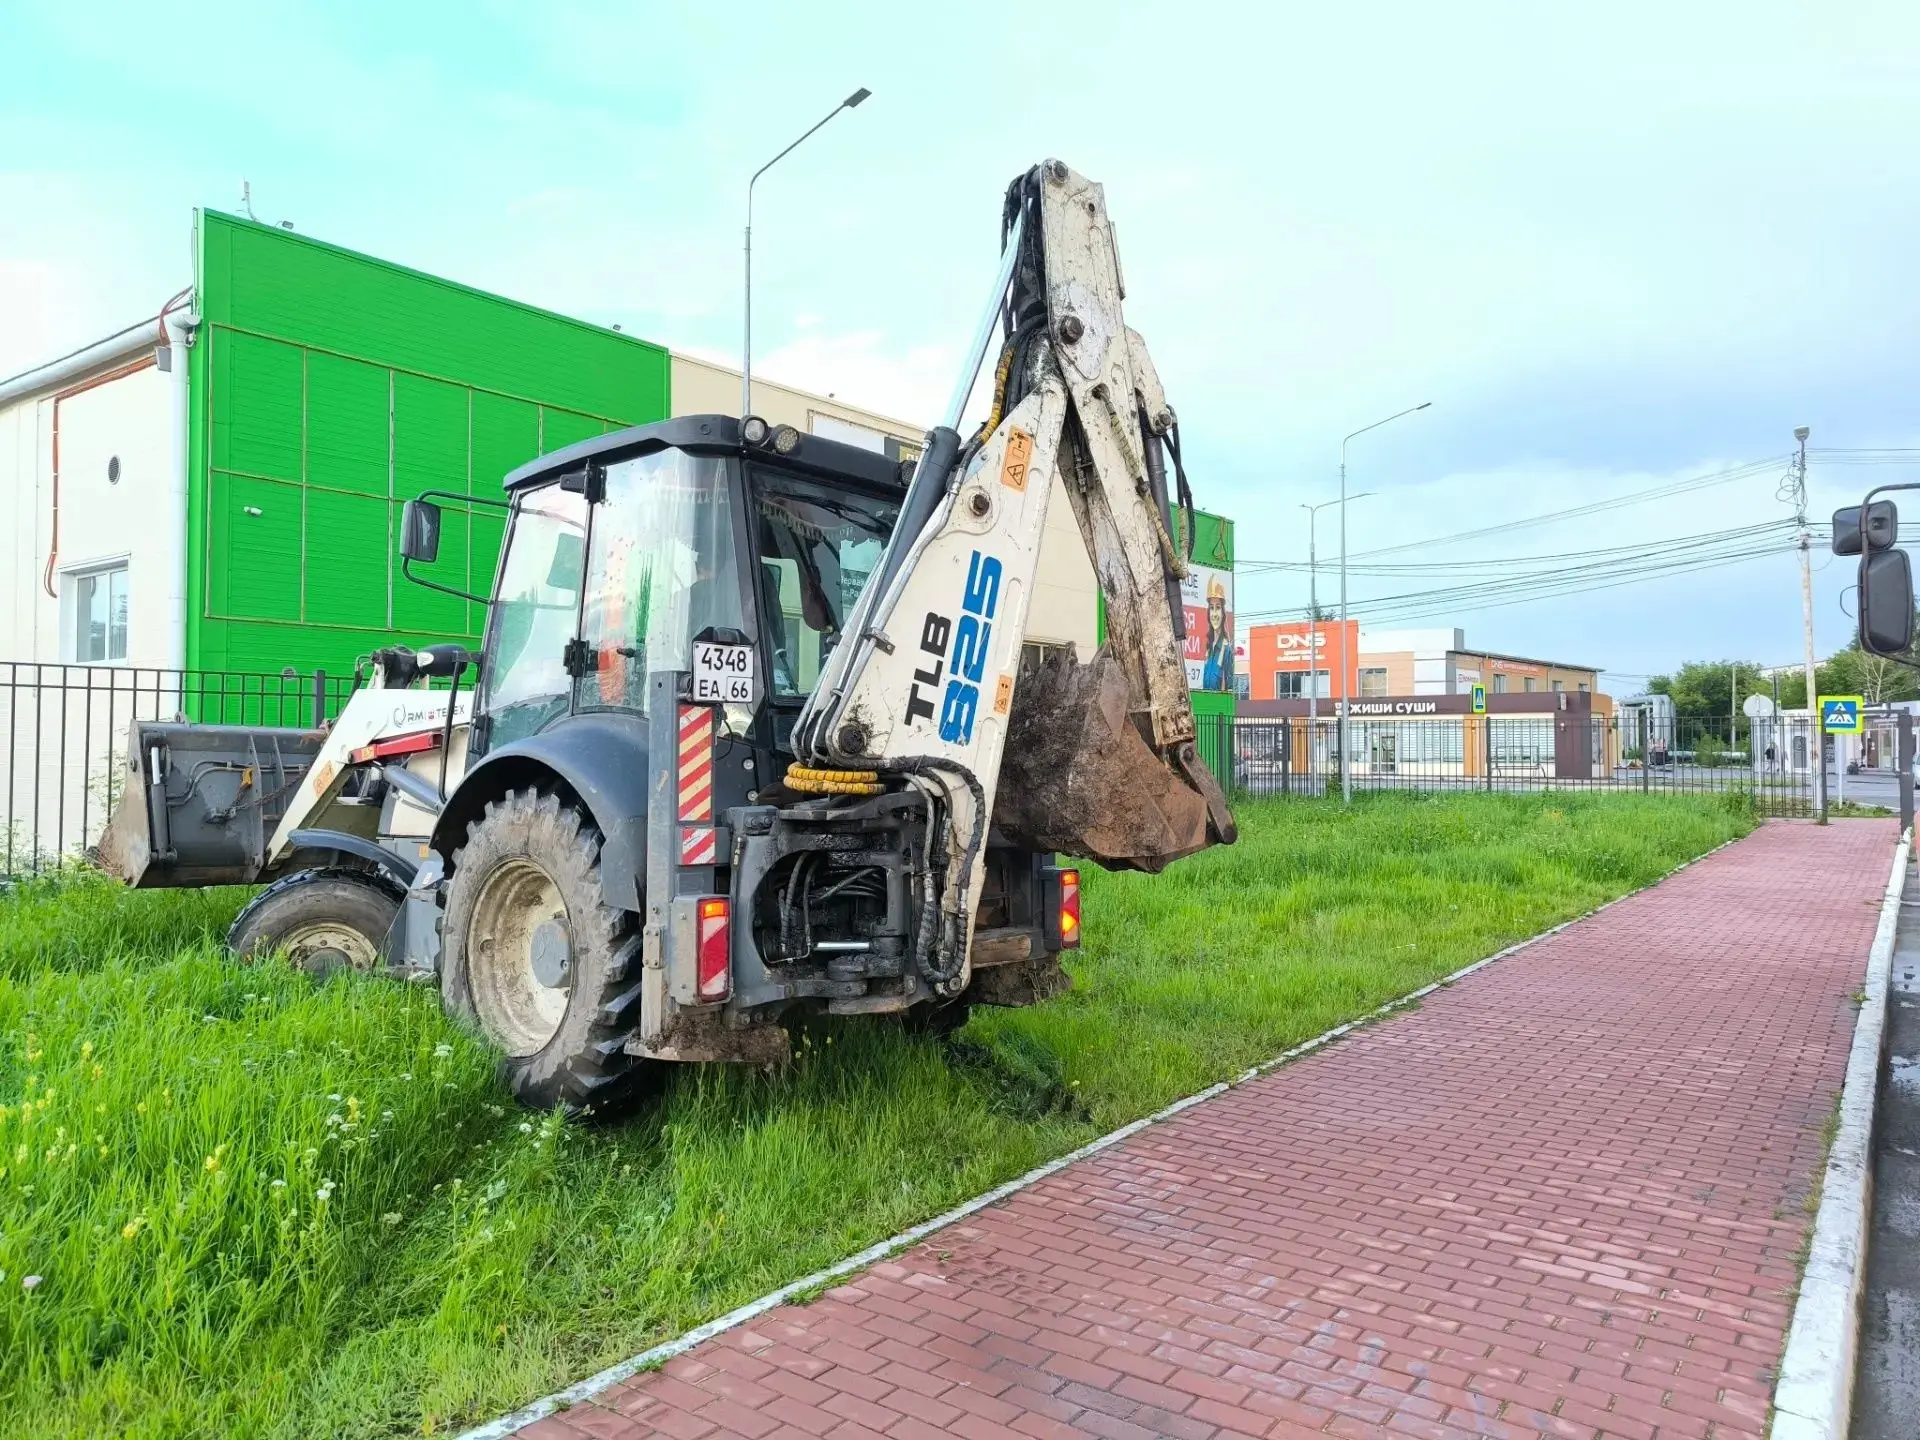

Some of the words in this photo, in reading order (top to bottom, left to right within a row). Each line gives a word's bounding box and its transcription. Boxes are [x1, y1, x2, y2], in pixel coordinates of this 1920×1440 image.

[1277, 631, 1327, 649] DNS
[701, 647, 747, 672] 4348
[904, 611, 951, 726] TLB
[731, 681, 749, 699] 66
[436, 704, 465, 719] TEEX
